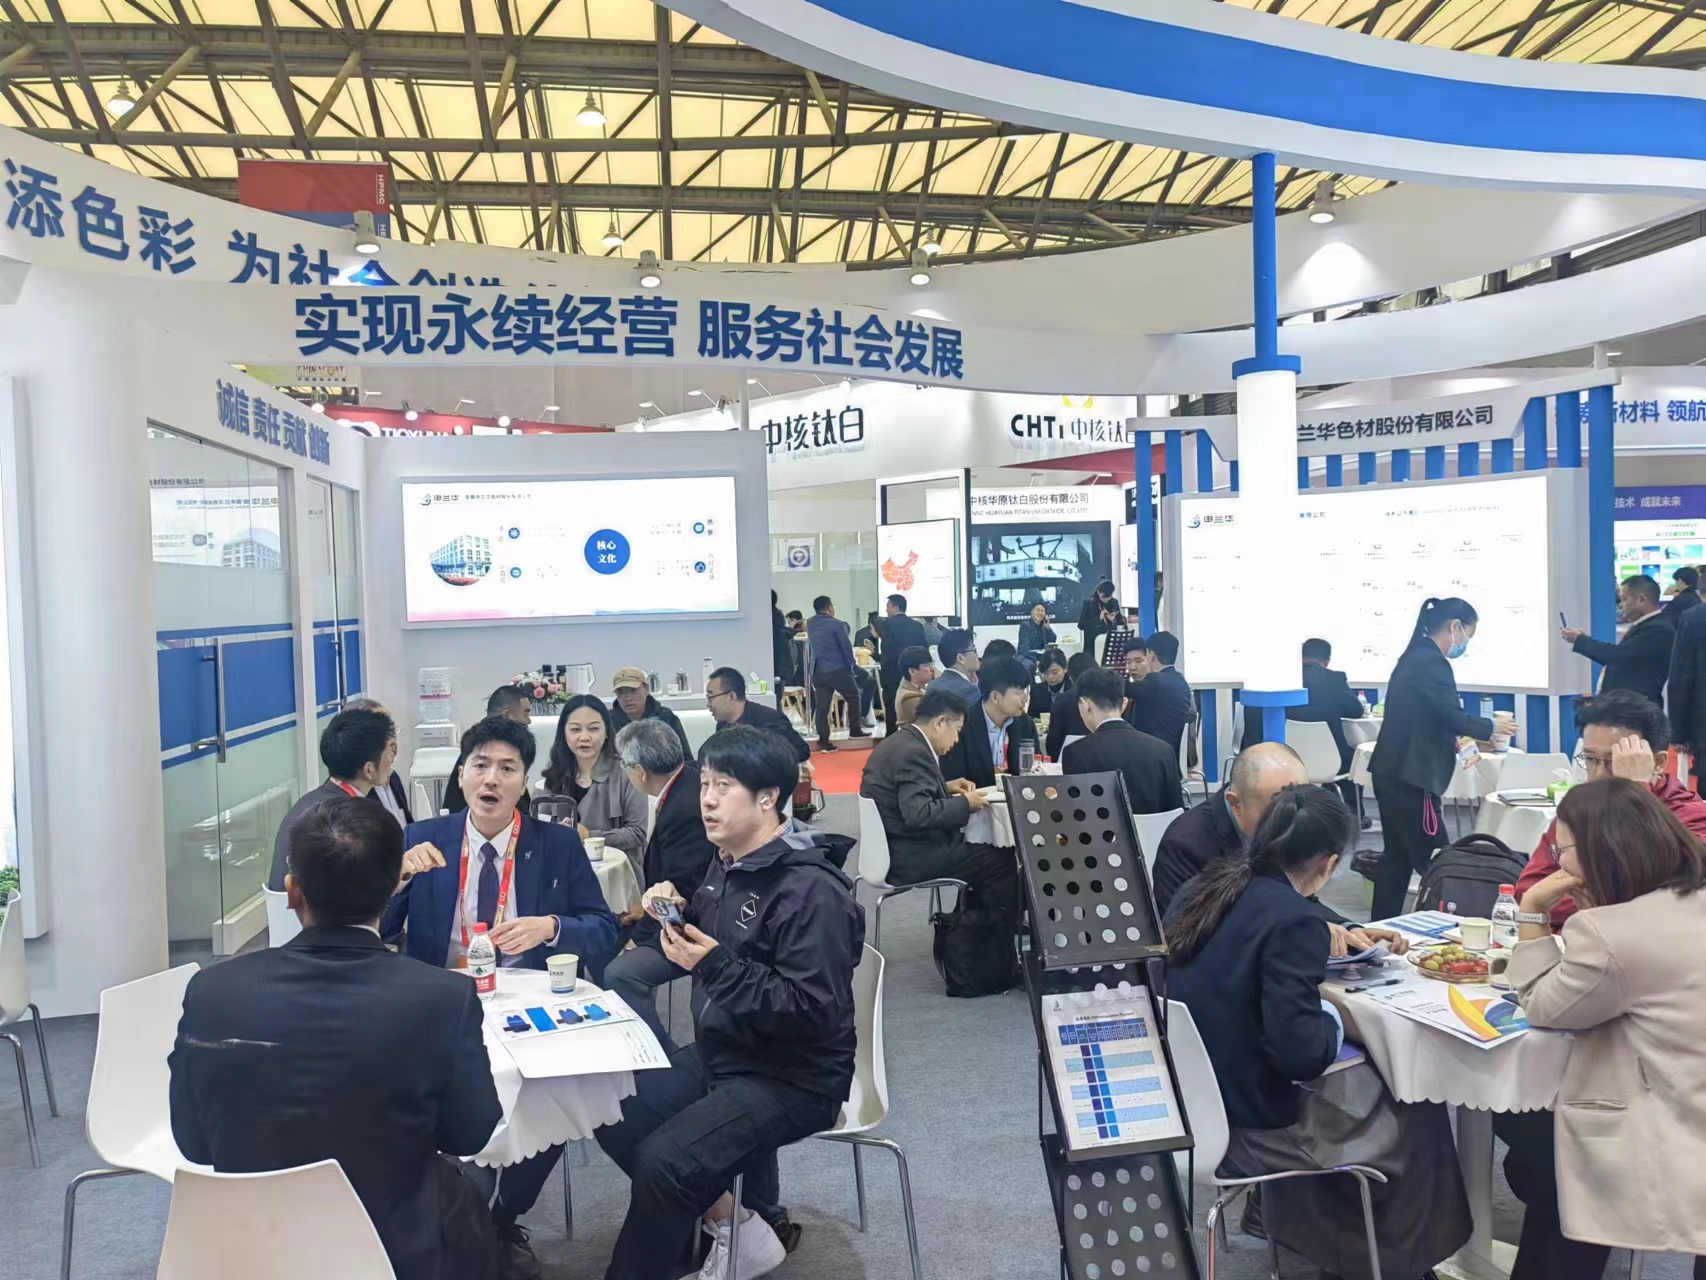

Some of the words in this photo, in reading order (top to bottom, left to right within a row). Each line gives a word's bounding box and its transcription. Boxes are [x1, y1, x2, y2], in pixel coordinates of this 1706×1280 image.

[377, 174, 386, 205] HPMC
[4, 158, 197, 275] 添色彩
[295, 293, 678, 357] 实现永续经营
[698, 300, 964, 380] 服务社会发展
[216, 379, 250, 436] 诚信
[252, 397, 280, 446] 责任
[282, 411, 307, 457] 贡献
[308, 422, 330, 466] 创新
[761, 405, 864, 454] 中核钛白
[1297, 404, 1494, 443] 兰华色材股份有限公司
[970, 493, 1089, 506] 中核华原钛白股份有限公司
[1640, 496, 1682, 508] 成就未来
[596, 540, 617, 551] 核心
[597, 553, 617, 564] 文化
